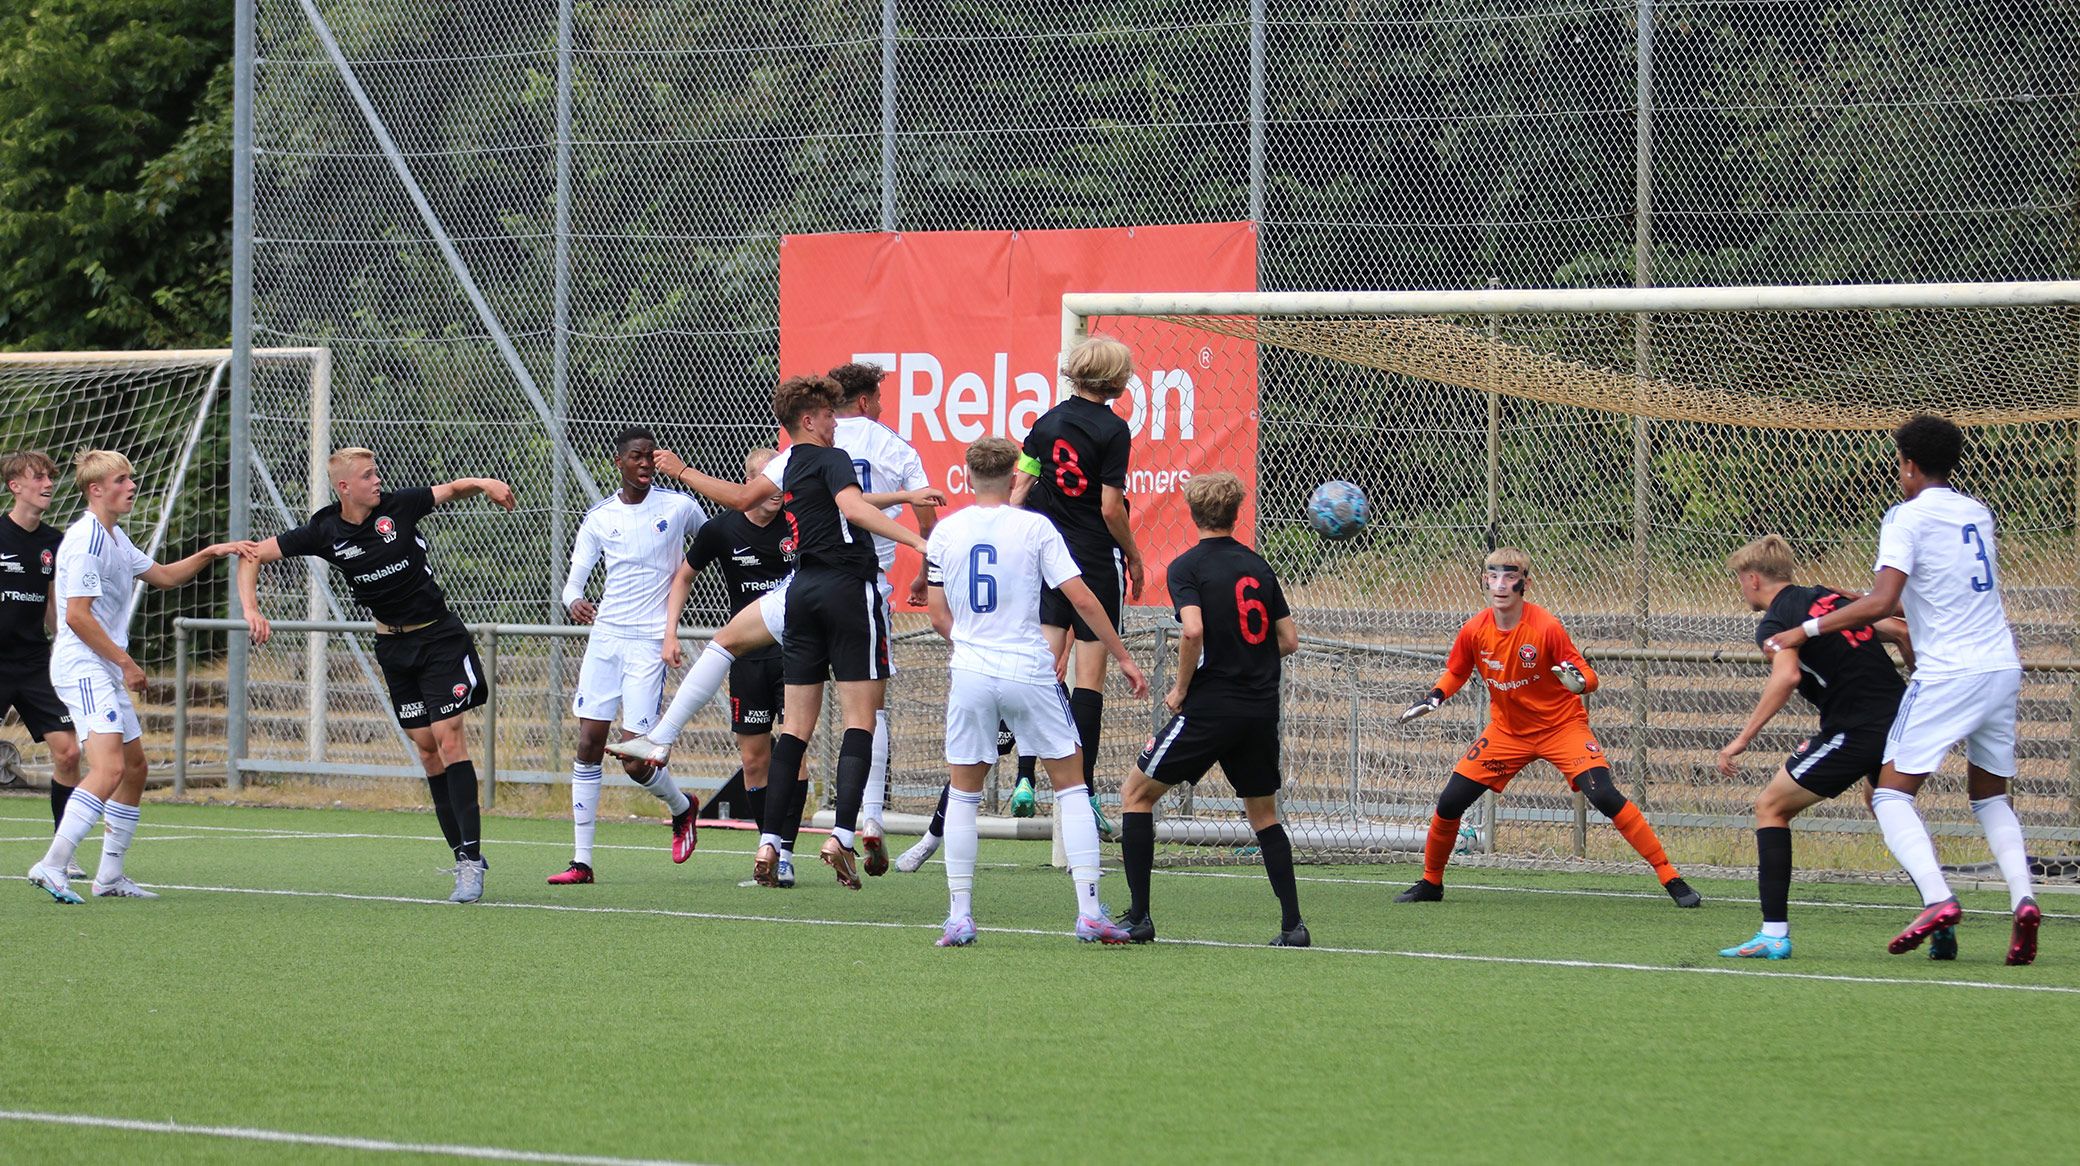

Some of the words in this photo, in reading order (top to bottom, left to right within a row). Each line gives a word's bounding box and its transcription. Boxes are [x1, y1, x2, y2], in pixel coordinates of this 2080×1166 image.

[1053, 439, 1088, 497] 8
[383, 531, 397, 544] U17
[1962, 523, 1993, 593] 3
[969, 543, 998, 614] 6
[1235, 576, 1269, 645] 6
[399, 709, 427, 719] KONDI
[401, 702, 424, 712] FAXE
[440, 703, 454, 714] U17
